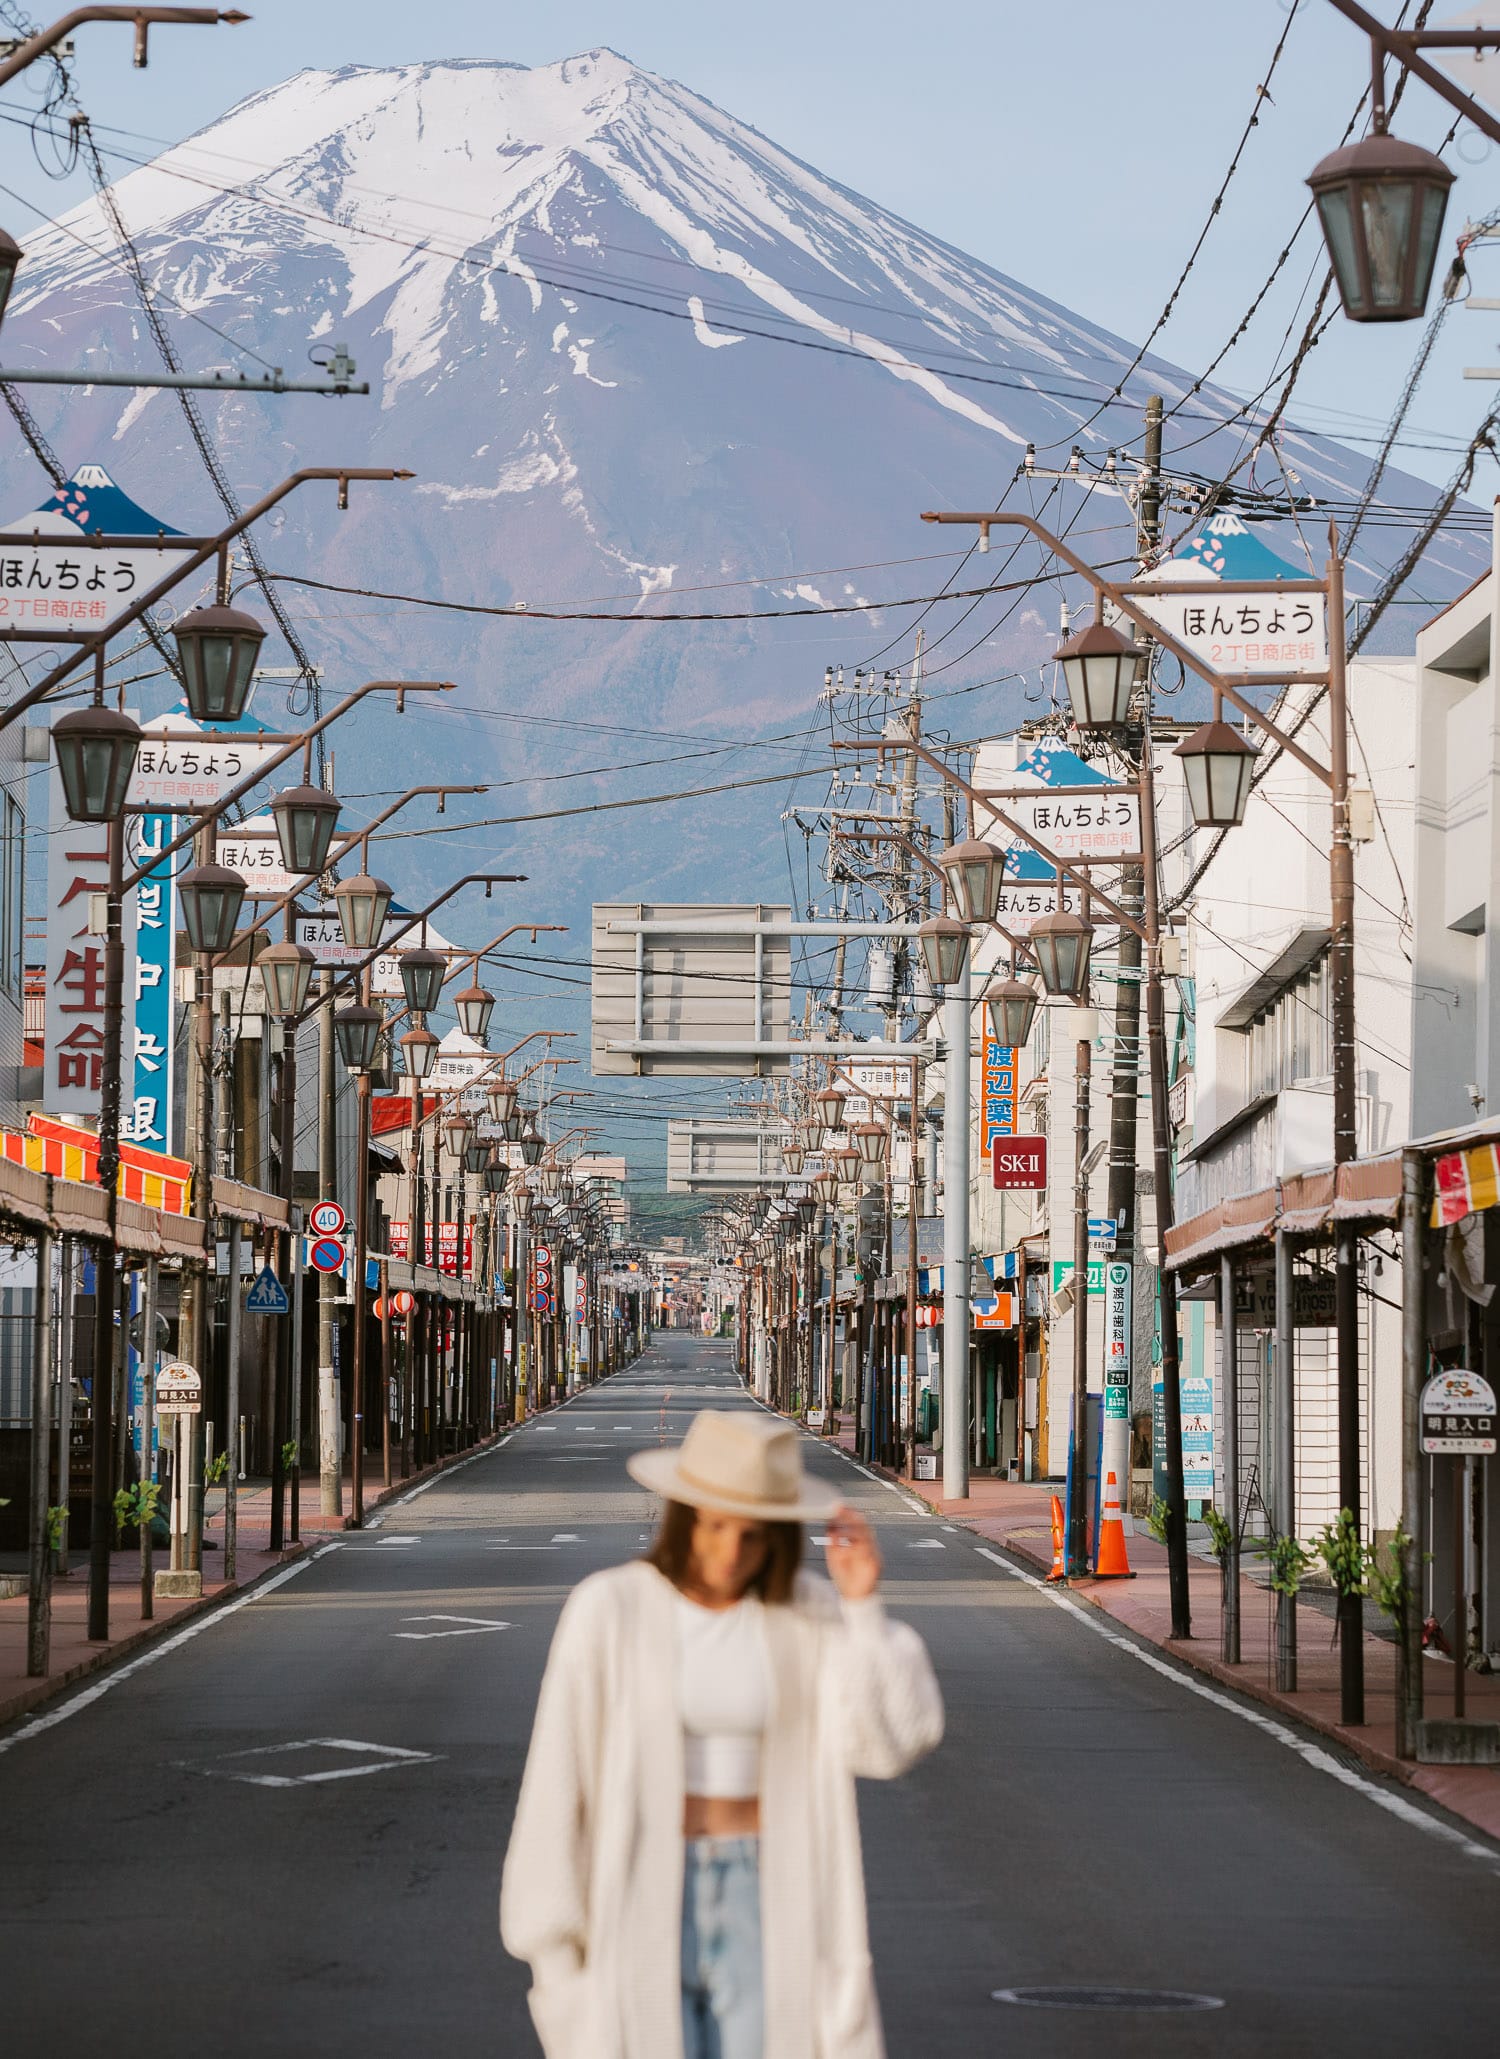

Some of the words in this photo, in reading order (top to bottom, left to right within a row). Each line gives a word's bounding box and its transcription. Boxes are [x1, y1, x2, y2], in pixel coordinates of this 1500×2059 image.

[0, 559, 135, 592] ほんちょう
[1184, 605, 1313, 635] ほんちょう
[1211, 642, 1315, 662] 2丁目商店街
[137, 751, 241, 776] ほんちょう
[135, 781, 220, 797] 2丁目商店街
[1033, 803, 1131, 829] ほんちょう
[1054, 832, 1133, 848] 2丁目商店街
[223, 848, 285, 867] ほんち
[244, 873, 292, 885] 目商店街
[304, 925, 344, 942] ほんち
[433, 1062, 474, 1075] 丁目商栄会
[861, 1071, 909, 1083] 3丁目商栄会
[1000, 1154, 1040, 1172] SK-II
[318, 1211, 337, 1226] 40
[1112, 1287, 1125, 1342] 渡辺歯科
[159, 1391, 198, 1400] 明見入口
[1427, 1417, 1492, 1431] 明見入口
